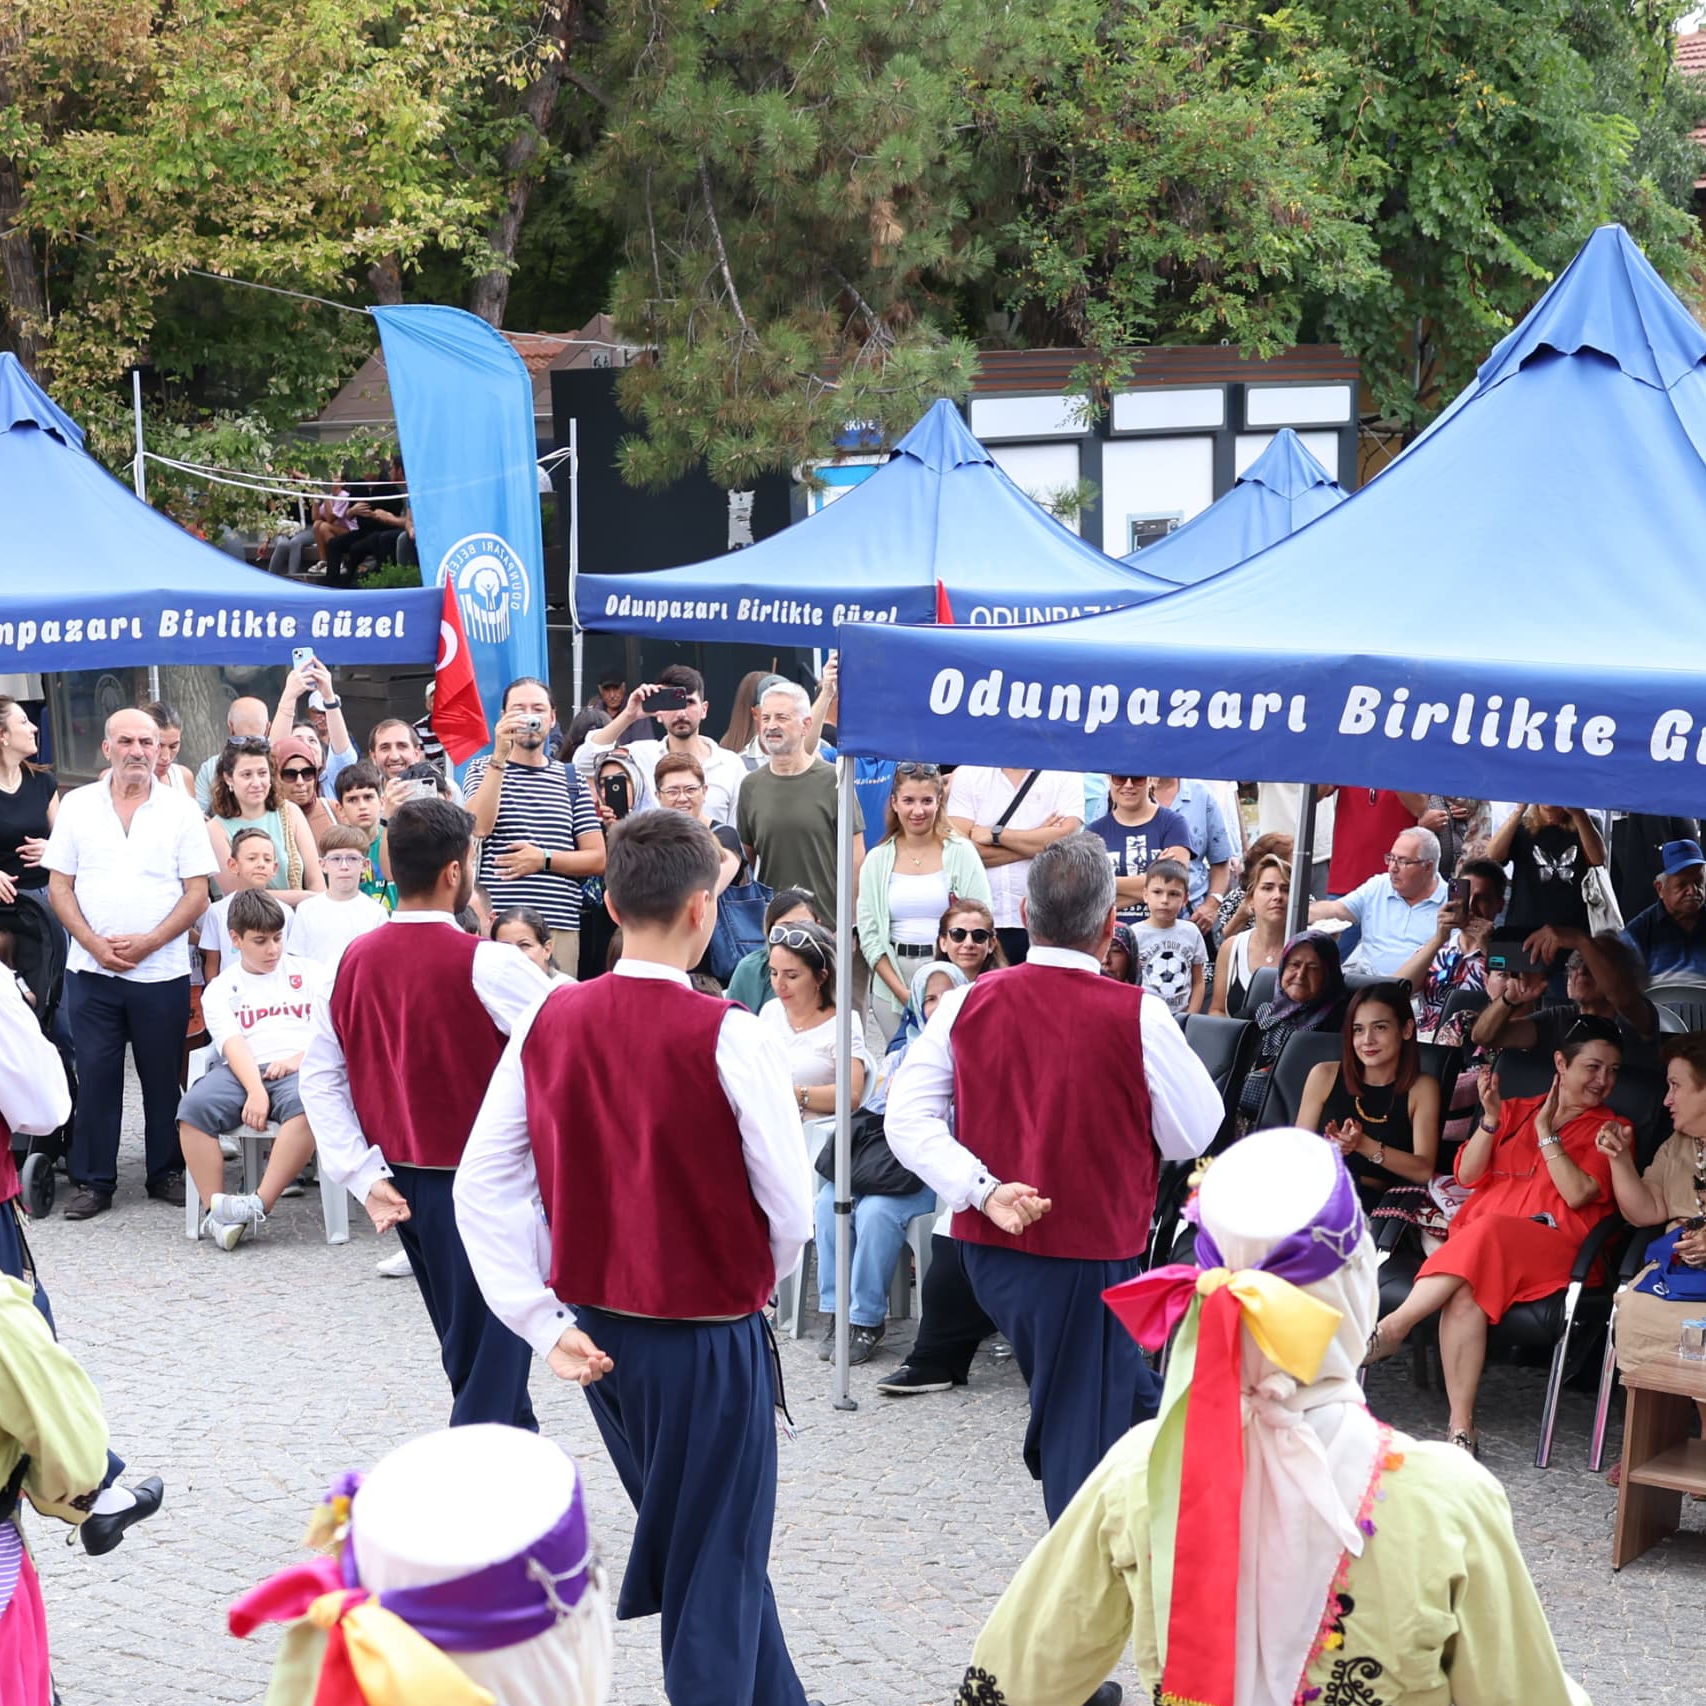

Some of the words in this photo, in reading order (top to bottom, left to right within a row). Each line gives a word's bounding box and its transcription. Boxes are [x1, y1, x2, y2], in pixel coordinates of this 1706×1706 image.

[158, 608, 297, 642] Birlikte
[311, 609, 405, 639] Güzel
[604, 594, 728, 623] Odunpazarı
[736, 598, 823, 626] Birlikte
[929, 667, 1307, 734] Odunpazarı
[1338, 684, 1617, 758] Birlikte
